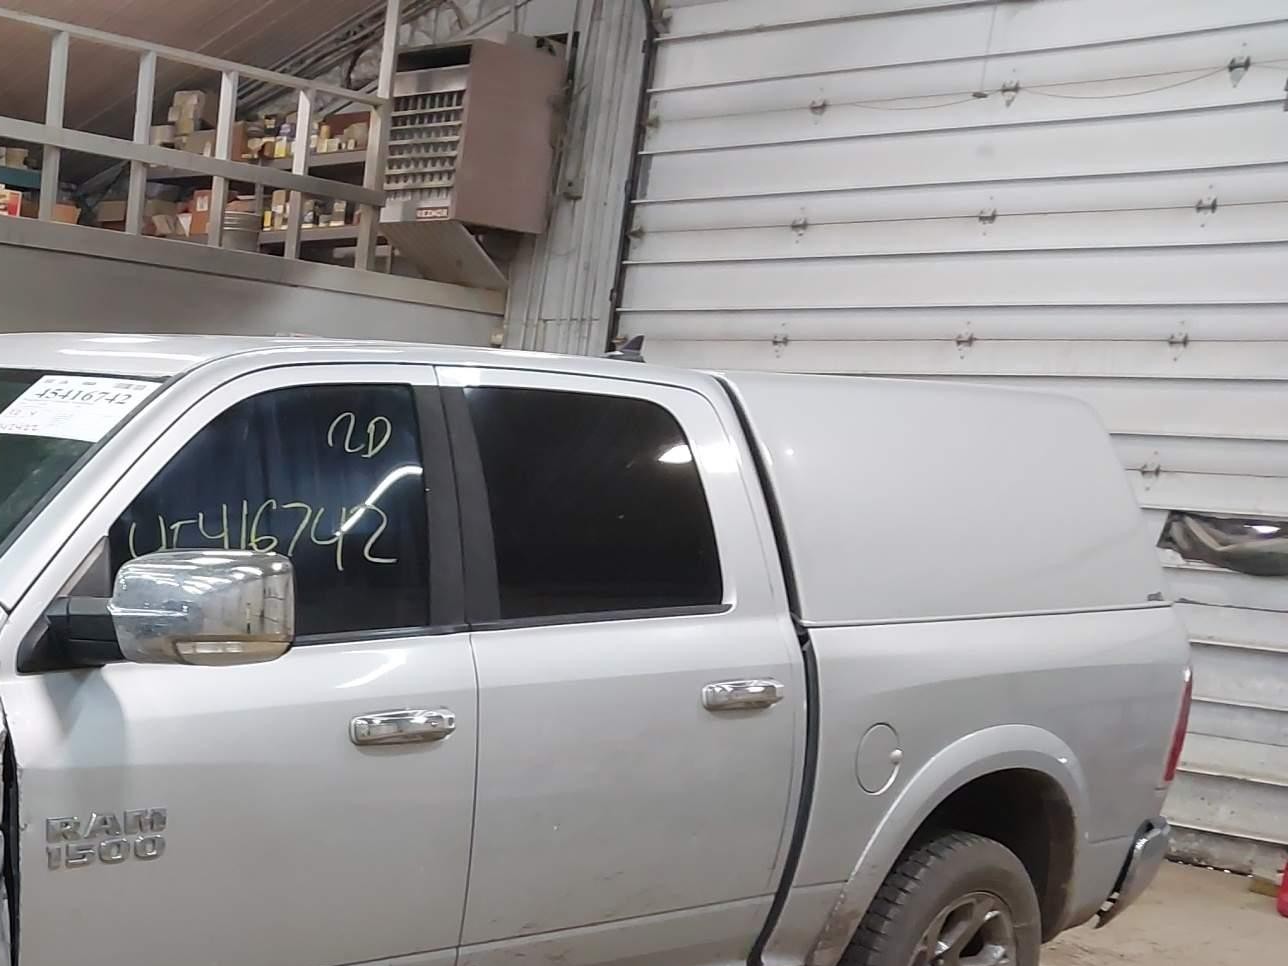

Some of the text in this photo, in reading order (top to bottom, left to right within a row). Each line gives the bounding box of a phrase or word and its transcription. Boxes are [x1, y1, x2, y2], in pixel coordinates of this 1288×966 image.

[33, 386, 134, 405] 45416742
[45, 807, 168, 844] RAM
[45, 834, 167, 871] 1500
